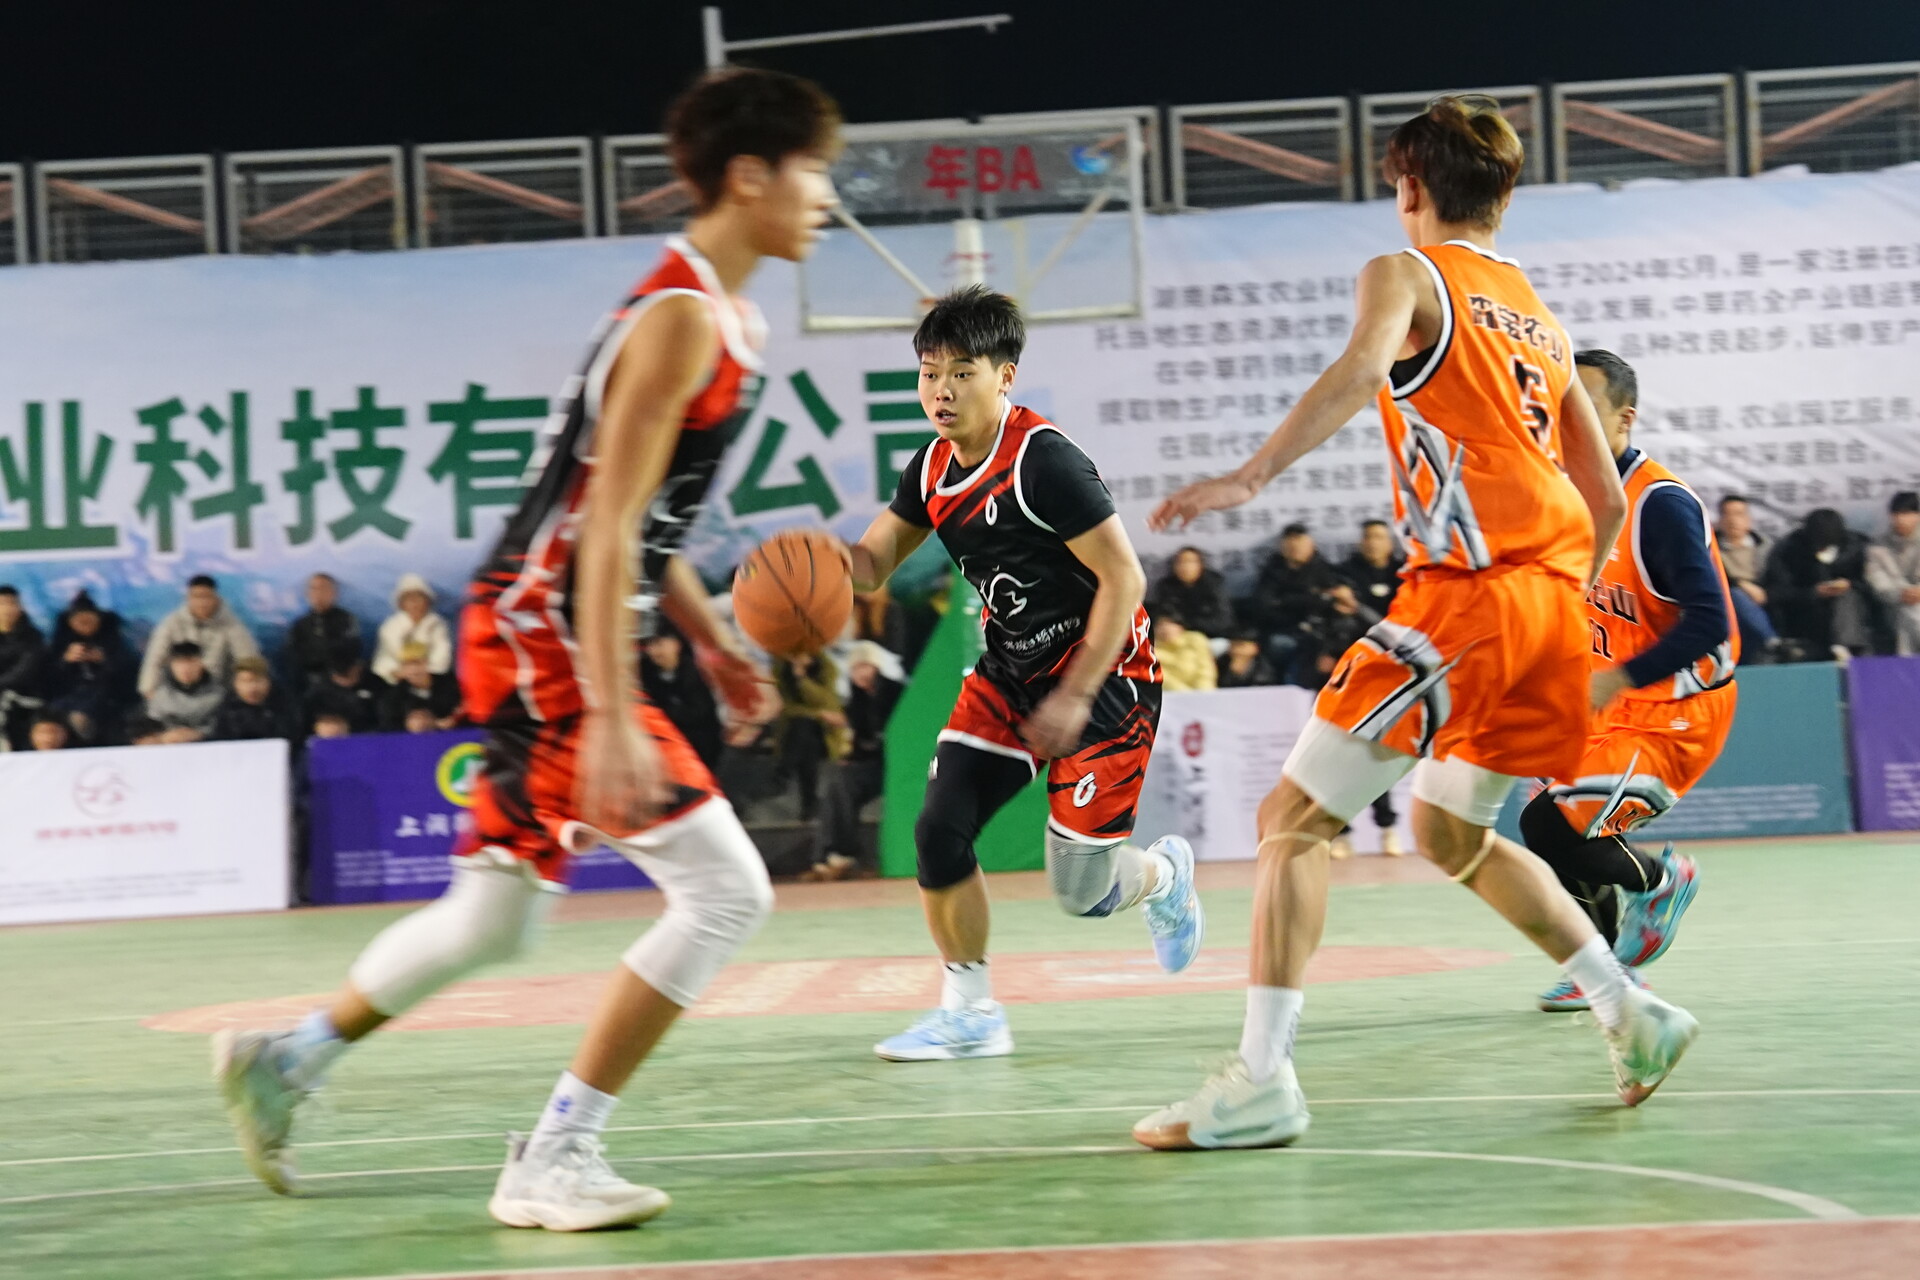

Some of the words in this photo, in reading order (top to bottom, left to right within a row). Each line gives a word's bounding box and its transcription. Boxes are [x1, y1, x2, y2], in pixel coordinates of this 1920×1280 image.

[1154, 275, 1358, 310] 湖南森宝农业科
